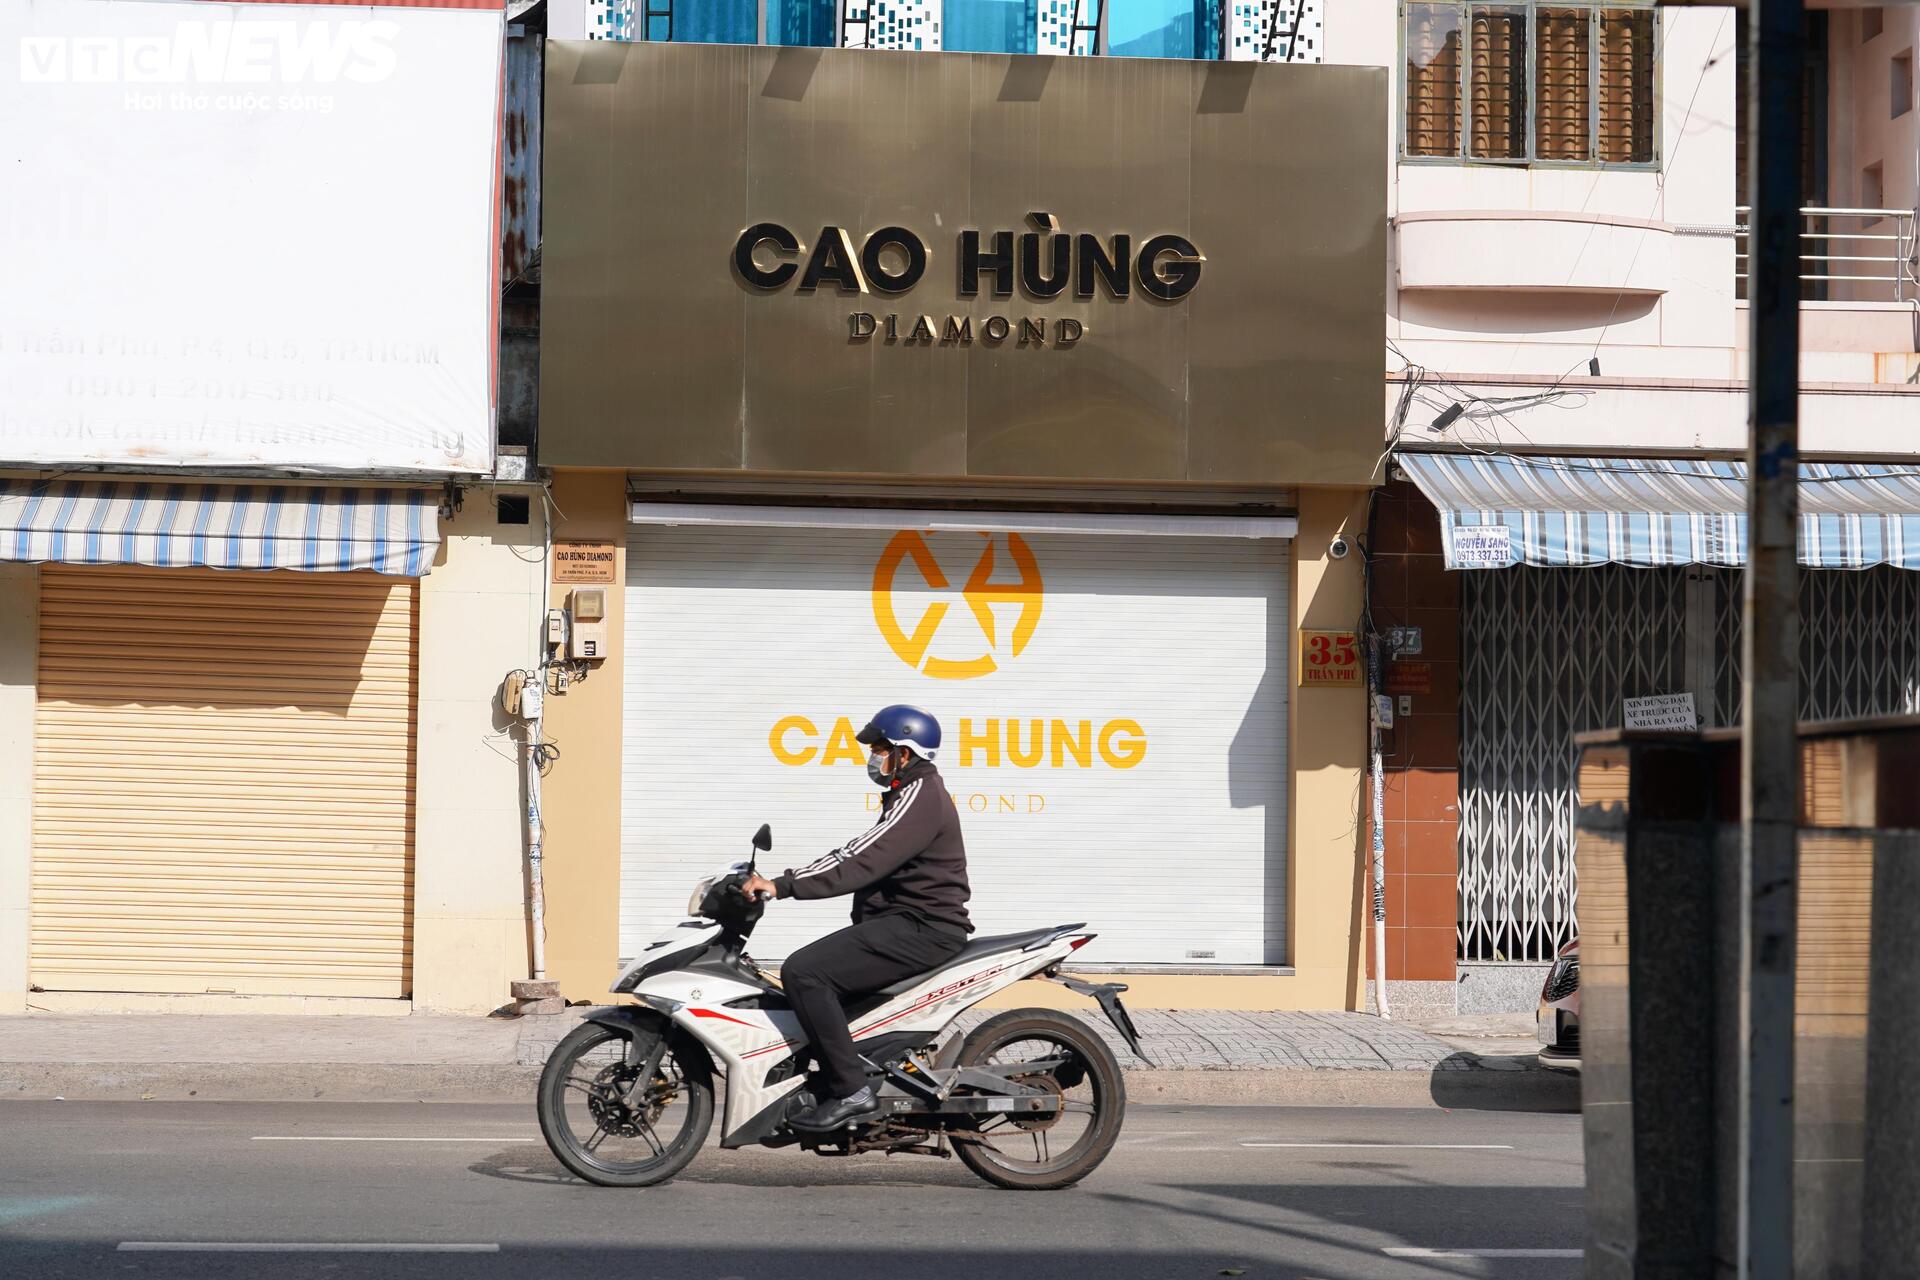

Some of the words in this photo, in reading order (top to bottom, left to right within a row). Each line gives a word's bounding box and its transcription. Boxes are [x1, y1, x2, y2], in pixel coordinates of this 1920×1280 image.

[734, 222, 930, 294] CAO
[960, 211, 1206, 300] HÙNG
[849, 311, 1088, 345] DIAMOND
[1488, 537, 1509, 548] SANG
[557, 551, 568, 561] CAO
[587, 552, 613, 562] DIAMOND
[1391, 630, 1418, 645] 37
[1310, 636, 1355, 665] 35
[1627, 700, 1642, 708] XIN
[1627, 710, 1638, 718] XE
[769, 715, 868, 767] CA
[958, 718, 1148, 769] HUNG
